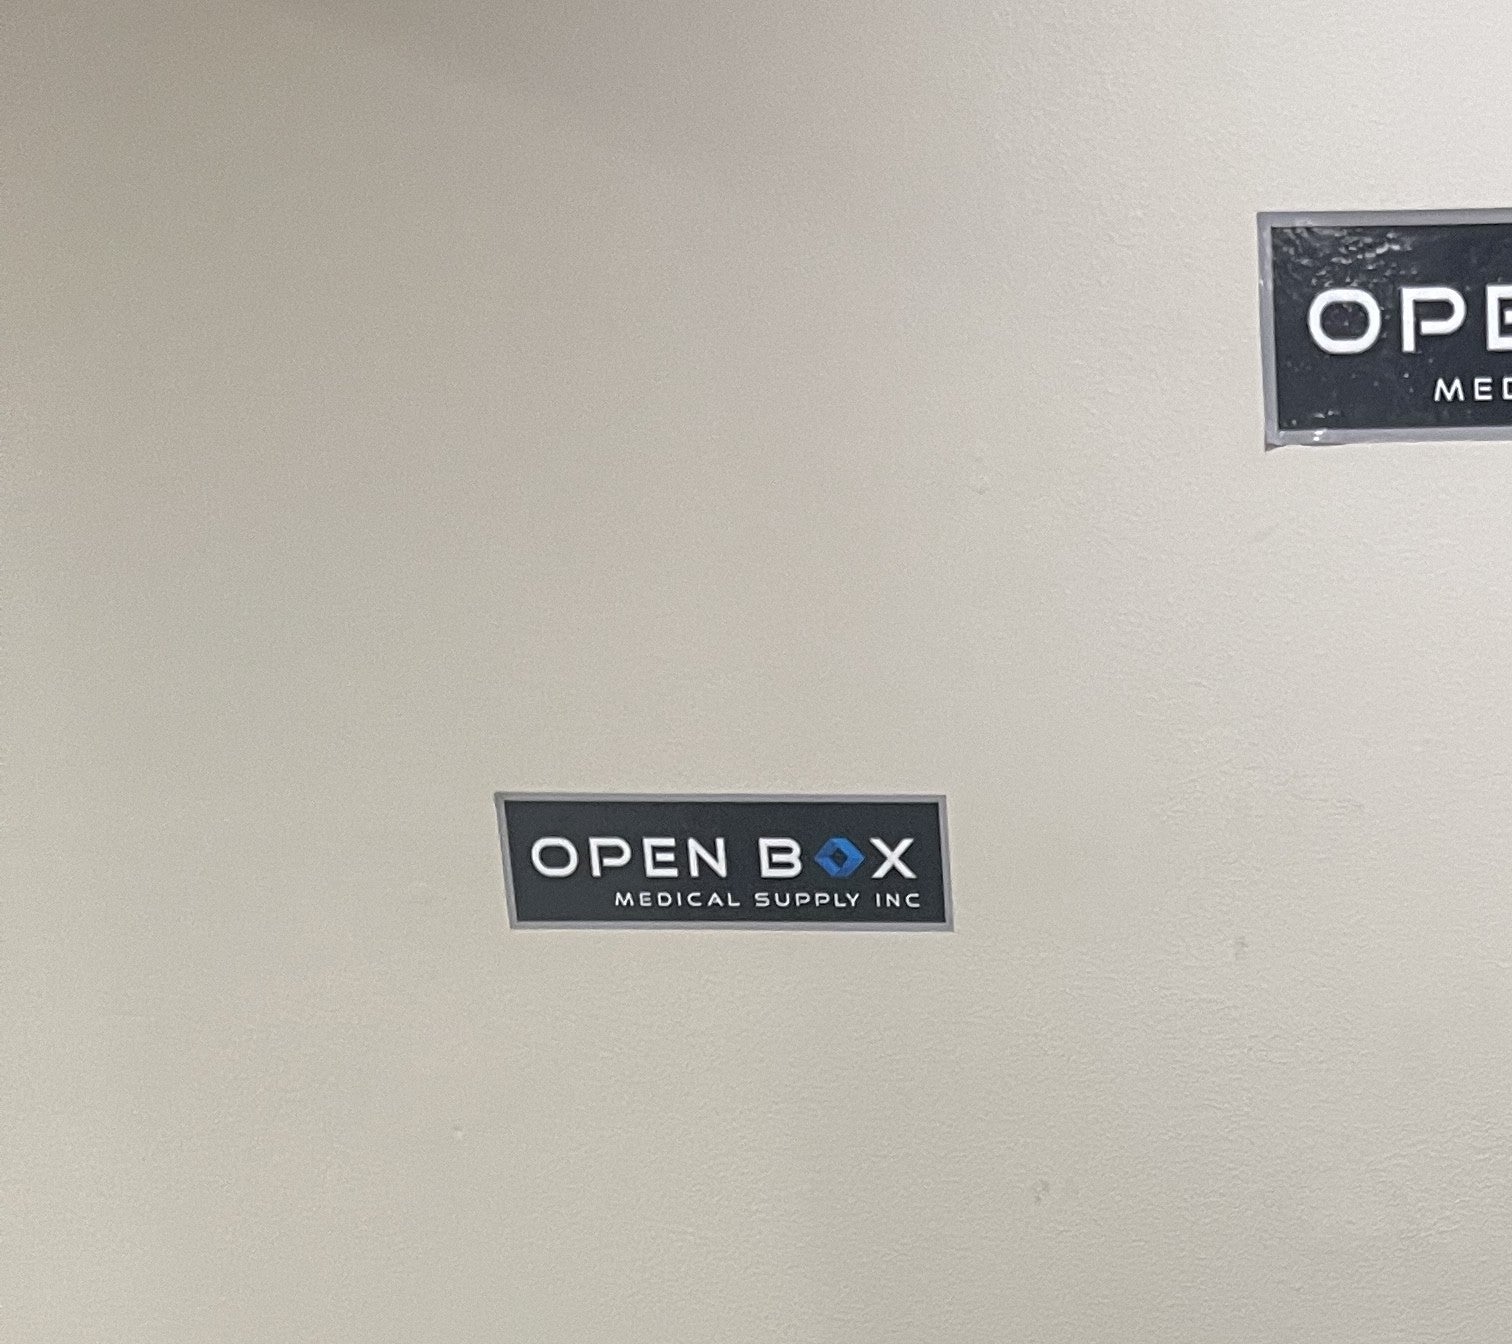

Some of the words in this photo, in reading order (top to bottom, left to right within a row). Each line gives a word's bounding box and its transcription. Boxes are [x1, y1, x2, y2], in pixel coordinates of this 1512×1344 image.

[530, 836, 729, 879] OPEN
[757, 836, 918, 880] BOX
[614, 891, 741, 908] MEDICAL
[754, 891, 861, 908] SUPPLY
[874, 891, 921, 909] INC
